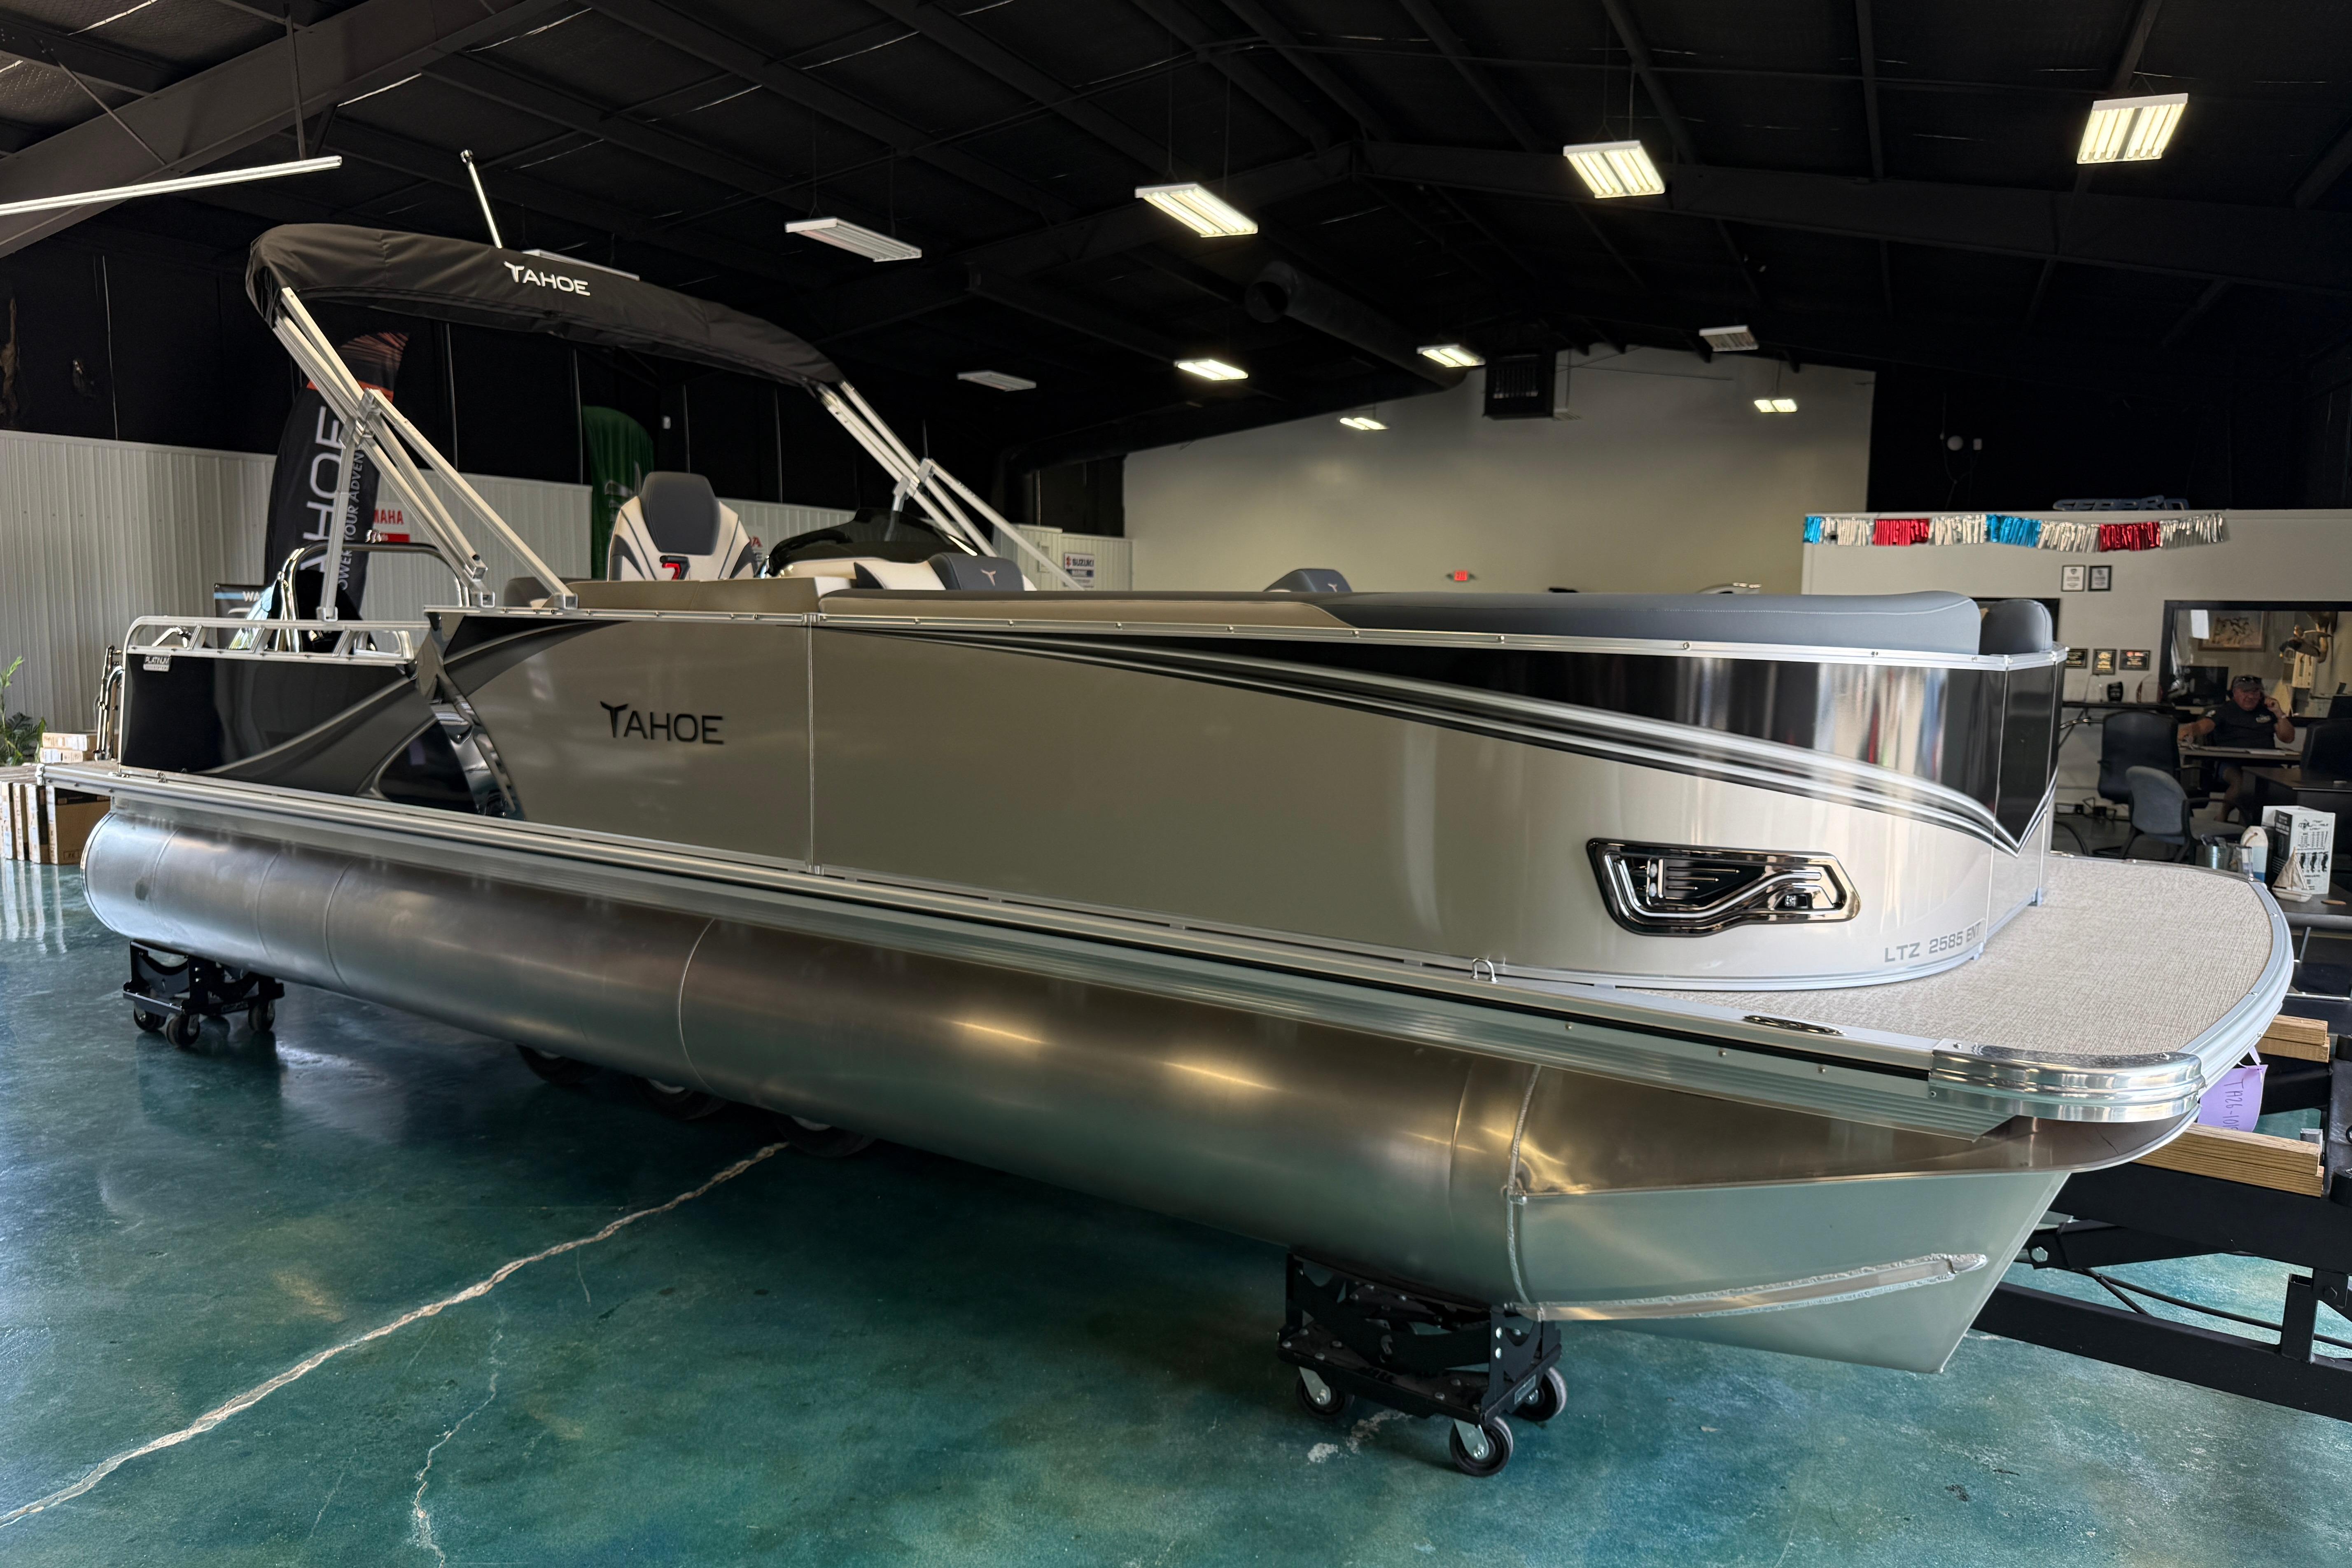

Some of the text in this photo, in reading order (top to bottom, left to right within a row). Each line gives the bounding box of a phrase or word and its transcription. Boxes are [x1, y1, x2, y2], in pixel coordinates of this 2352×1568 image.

[503, 261, 590, 296] TAHOE
[600, 701, 724, 744] TAHOE
[1884, 942, 1920, 962] LTZ
[1929, 931, 1963, 954] 2585
